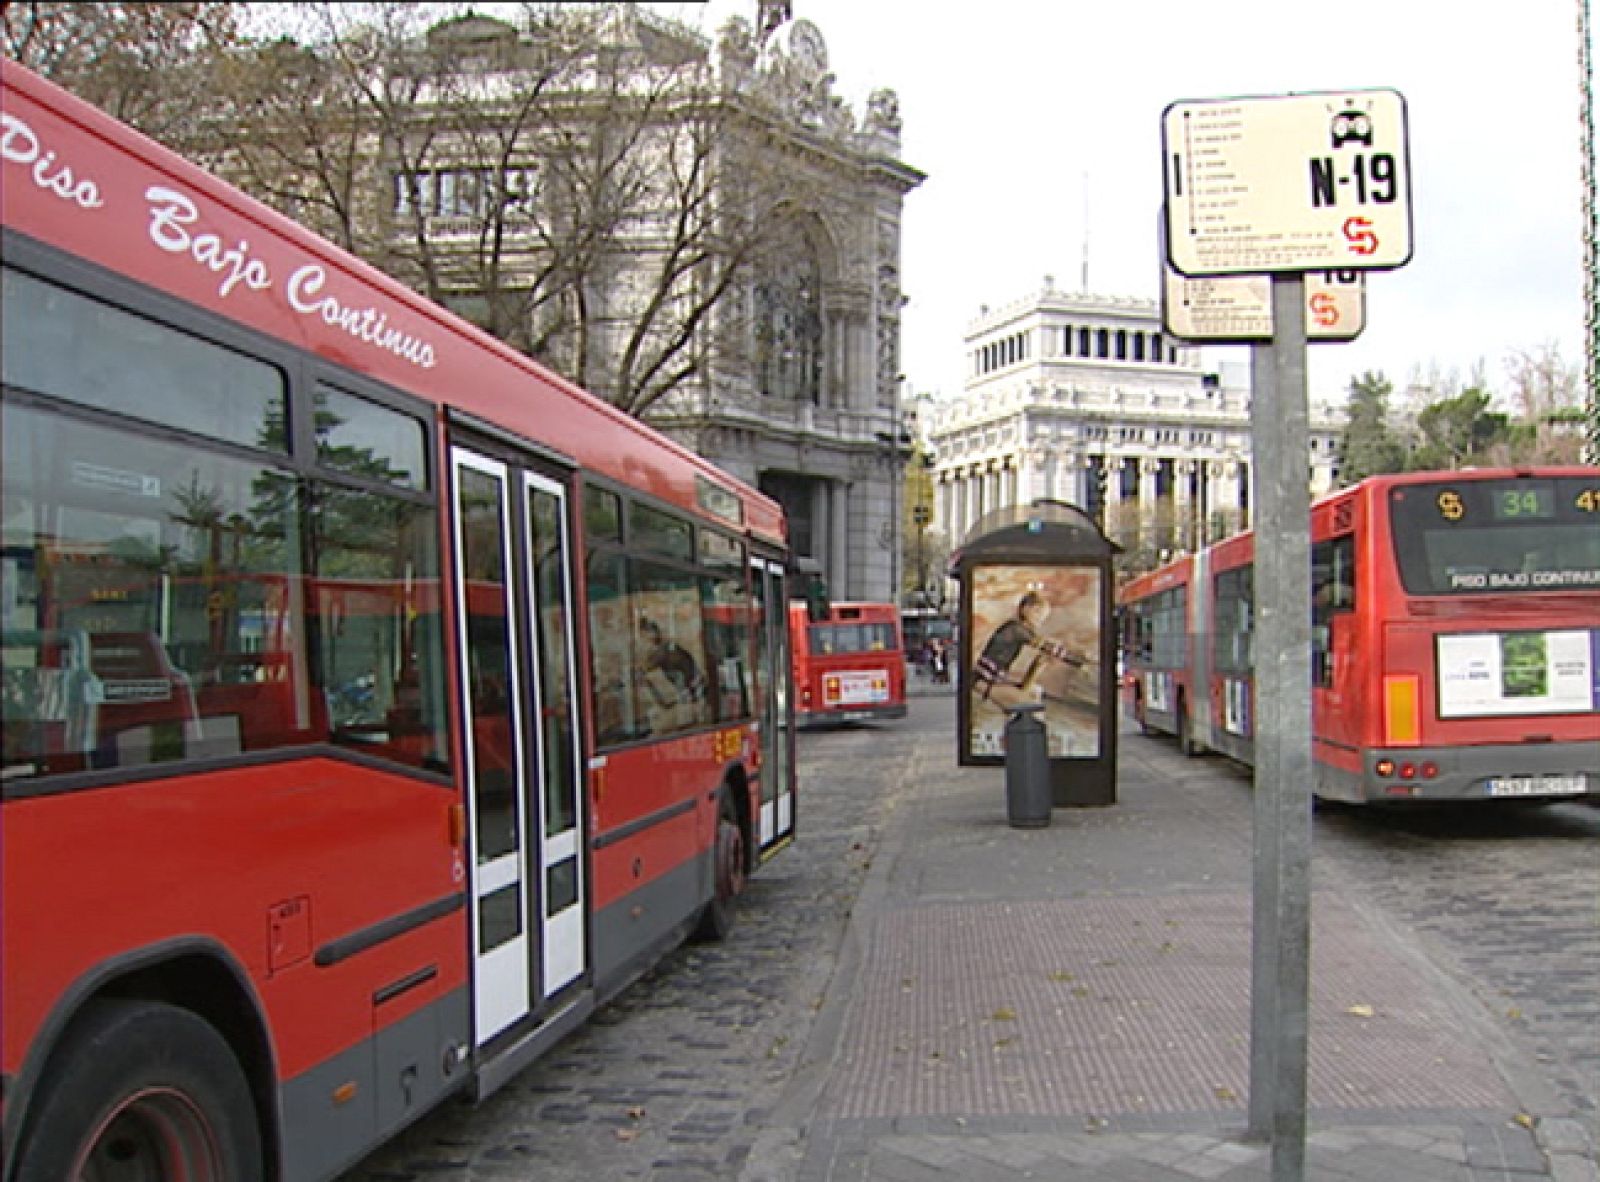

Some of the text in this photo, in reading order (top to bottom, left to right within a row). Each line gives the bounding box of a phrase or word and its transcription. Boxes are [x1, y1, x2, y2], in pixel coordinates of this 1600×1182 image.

[1309, 154, 1397, 207] N-19
[145, 186, 272, 297] Bajo
[1503, 490, 1537, 516] 34
